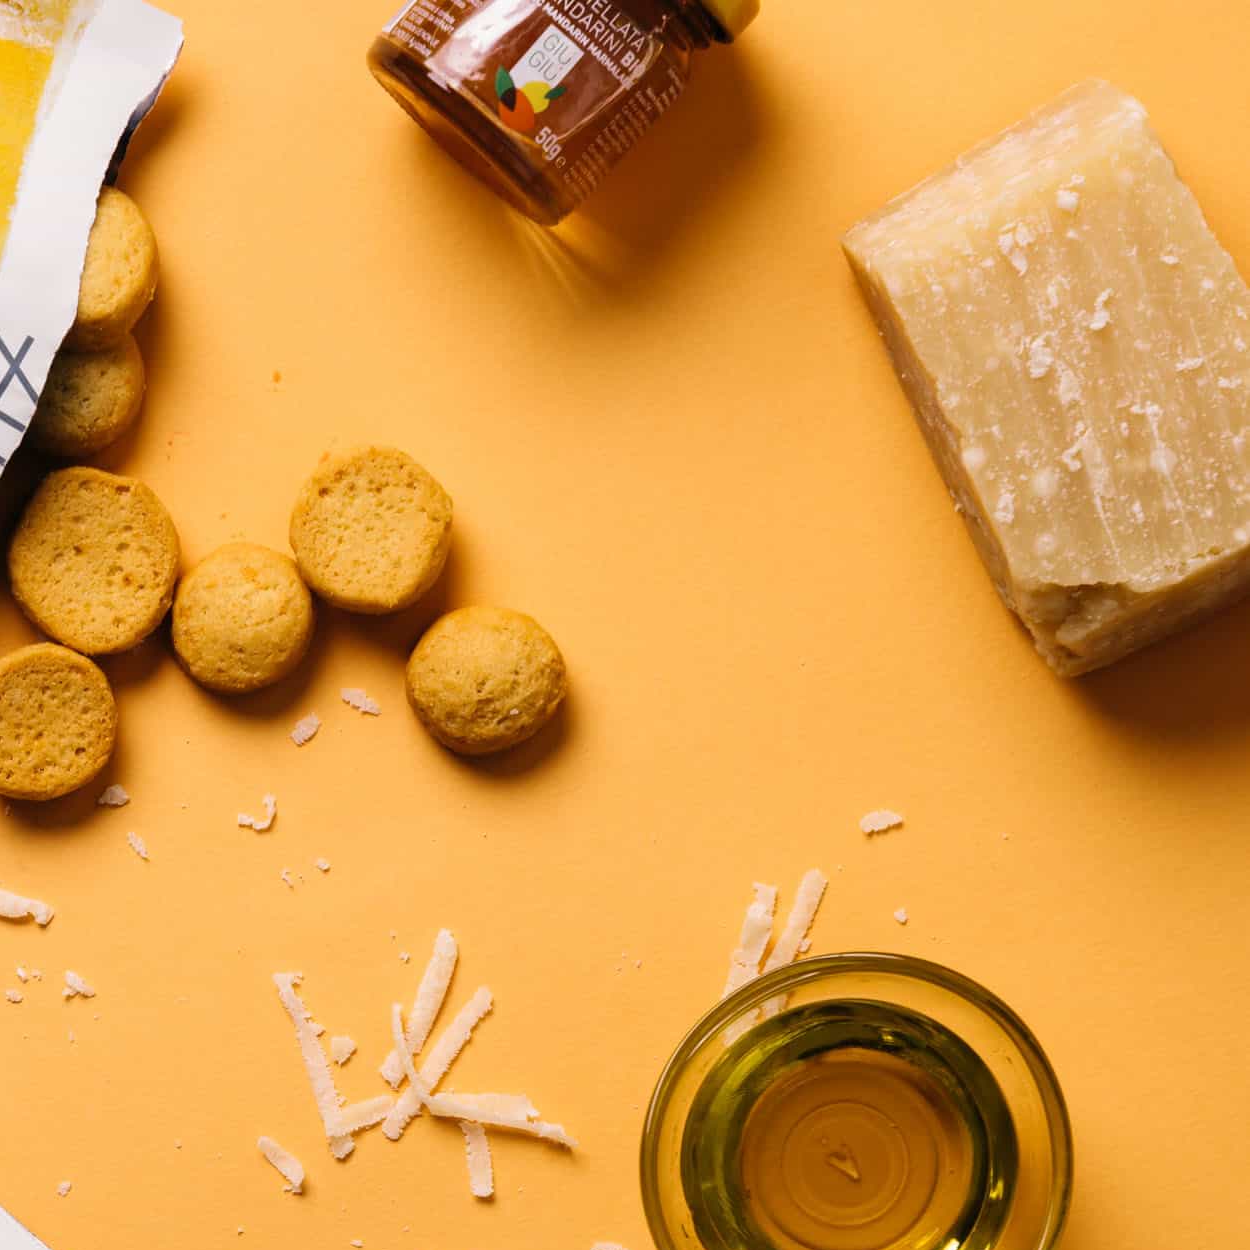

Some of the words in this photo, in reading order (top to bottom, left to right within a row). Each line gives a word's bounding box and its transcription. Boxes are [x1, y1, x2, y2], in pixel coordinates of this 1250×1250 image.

[542, 2, 590, 46] MANDARIN
[556, 0, 624, 56] NDARINI
[586, 0, 645, 52] ELLATA
